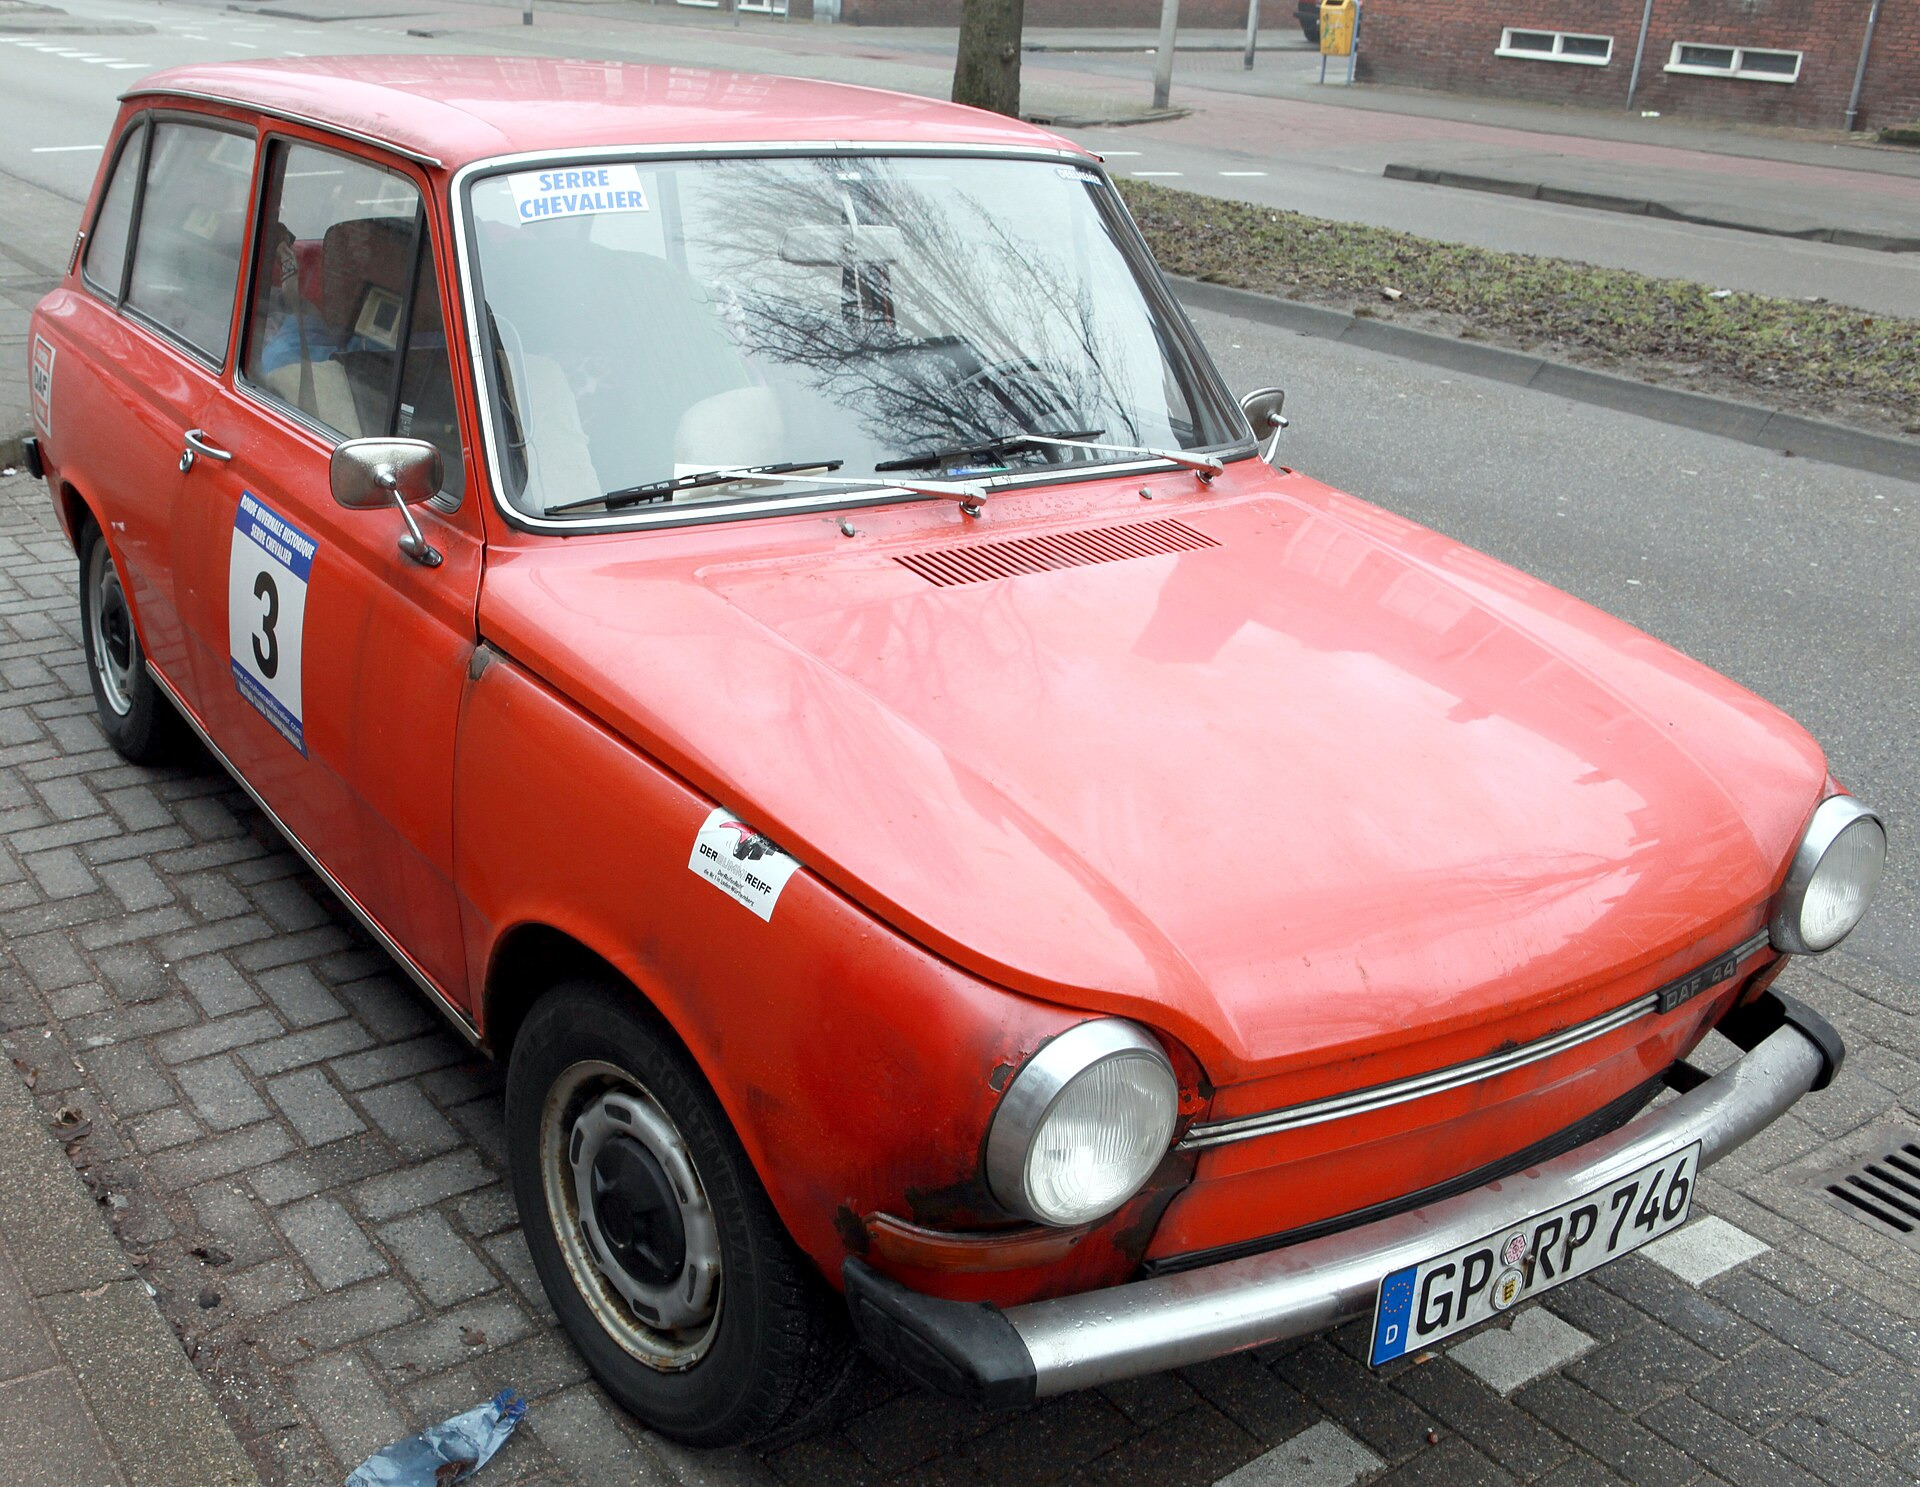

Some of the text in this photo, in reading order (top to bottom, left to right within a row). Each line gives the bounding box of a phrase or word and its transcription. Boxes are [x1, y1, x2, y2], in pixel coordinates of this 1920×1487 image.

[539, 169, 610, 192] SERRE
[519, 190, 643, 219] CHEVALIER
[251, 523, 292, 566] SERRE CHEVALIER
[281, 526, 315, 560] HISTORIQUE
[252, 570, 279, 680] 3
[744, 872, 772, 896] REIFF
[1666, 960, 1735, 1010] DAF 44
[1415, 1157, 1690, 1336] GP RP 746
[1384, 1324, 1399, 1346] D
